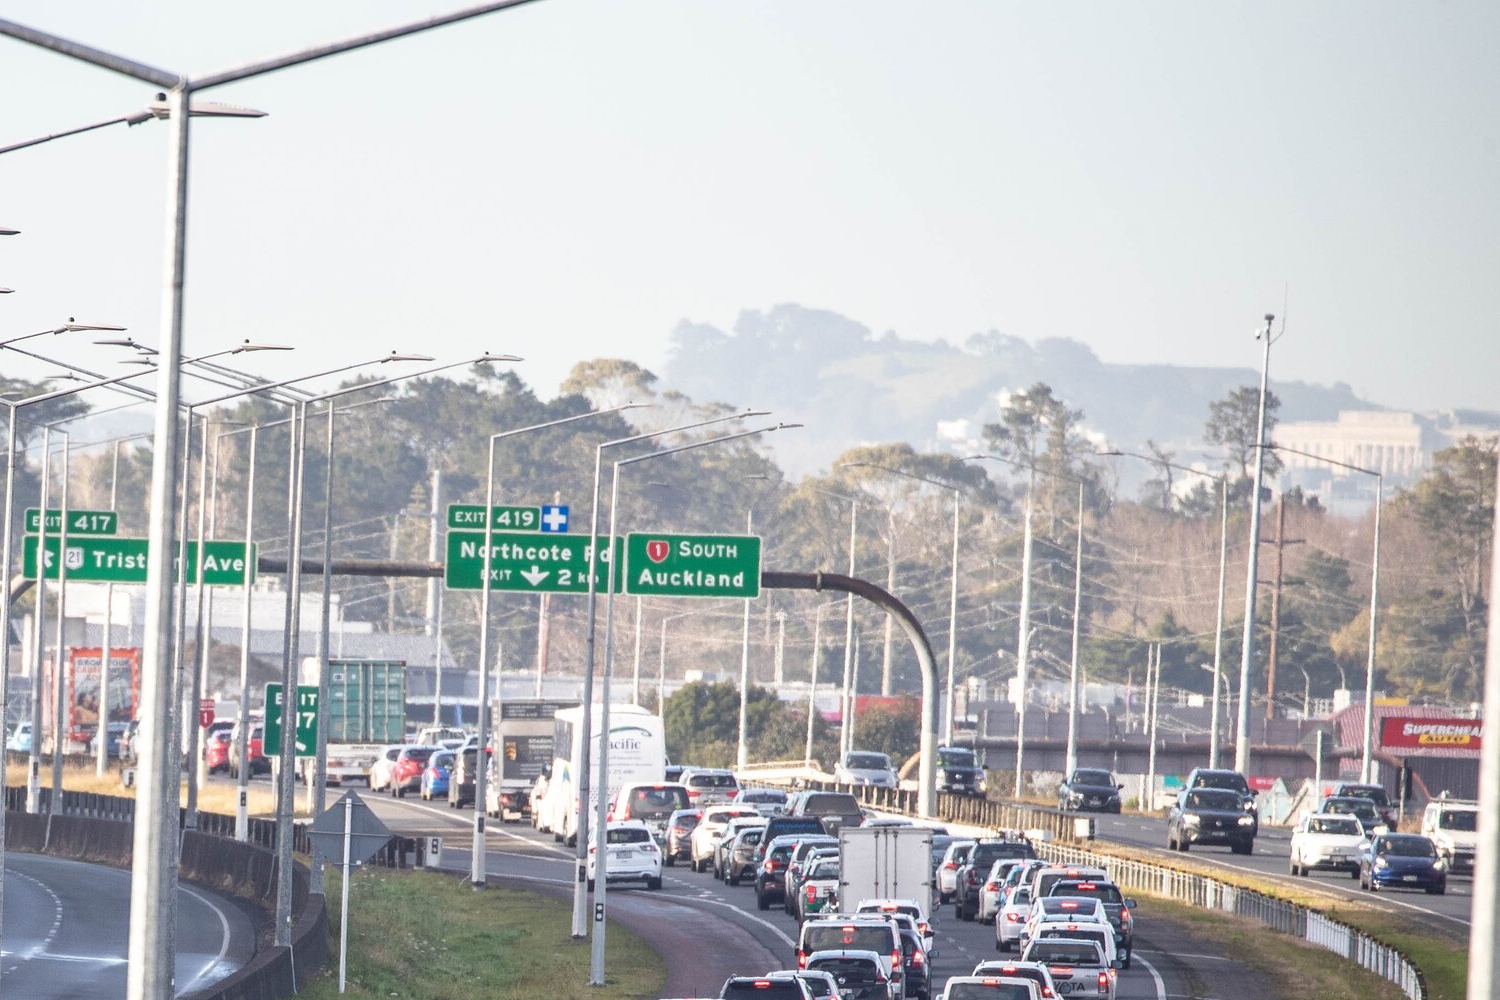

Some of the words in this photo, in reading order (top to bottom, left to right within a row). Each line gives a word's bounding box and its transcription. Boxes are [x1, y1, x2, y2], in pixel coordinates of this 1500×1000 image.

[74, 515, 112, 531] 417
[455, 511, 485, 523] EXIT
[497, 511, 534, 526] 419
[460, 541, 572, 561] Northcote
[655, 544, 661, 557] 1
[679, 541, 737, 558] SOUTH
[68, 551, 80, 563] 21
[203, 555, 243, 571] Ave
[557, 569, 572, 586] 2
[638, 568, 744, 588] Auckland
[275, 692, 317, 706] EIT
